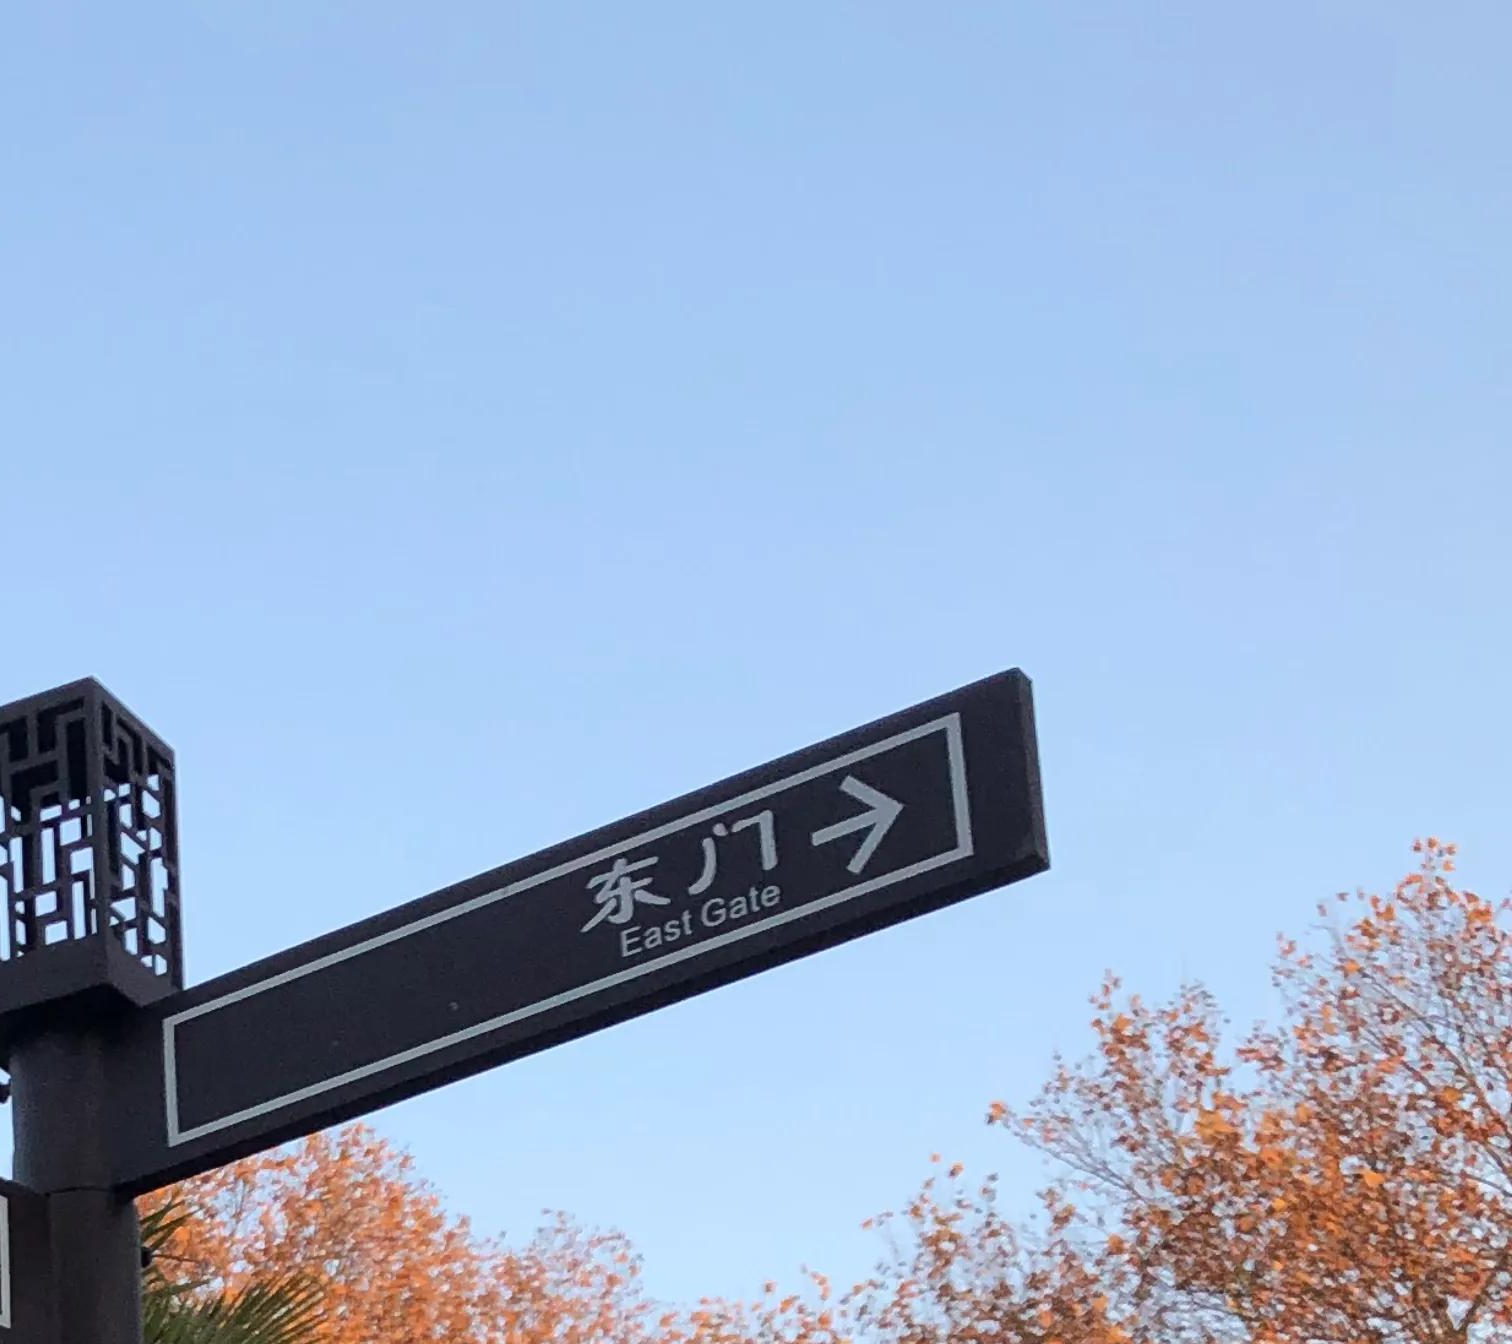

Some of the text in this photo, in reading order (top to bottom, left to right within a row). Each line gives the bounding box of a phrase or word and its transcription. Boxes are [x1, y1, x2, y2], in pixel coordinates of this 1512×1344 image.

[580, 811, 778, 932] 东门
[621, 885, 780, 958] East Gate
